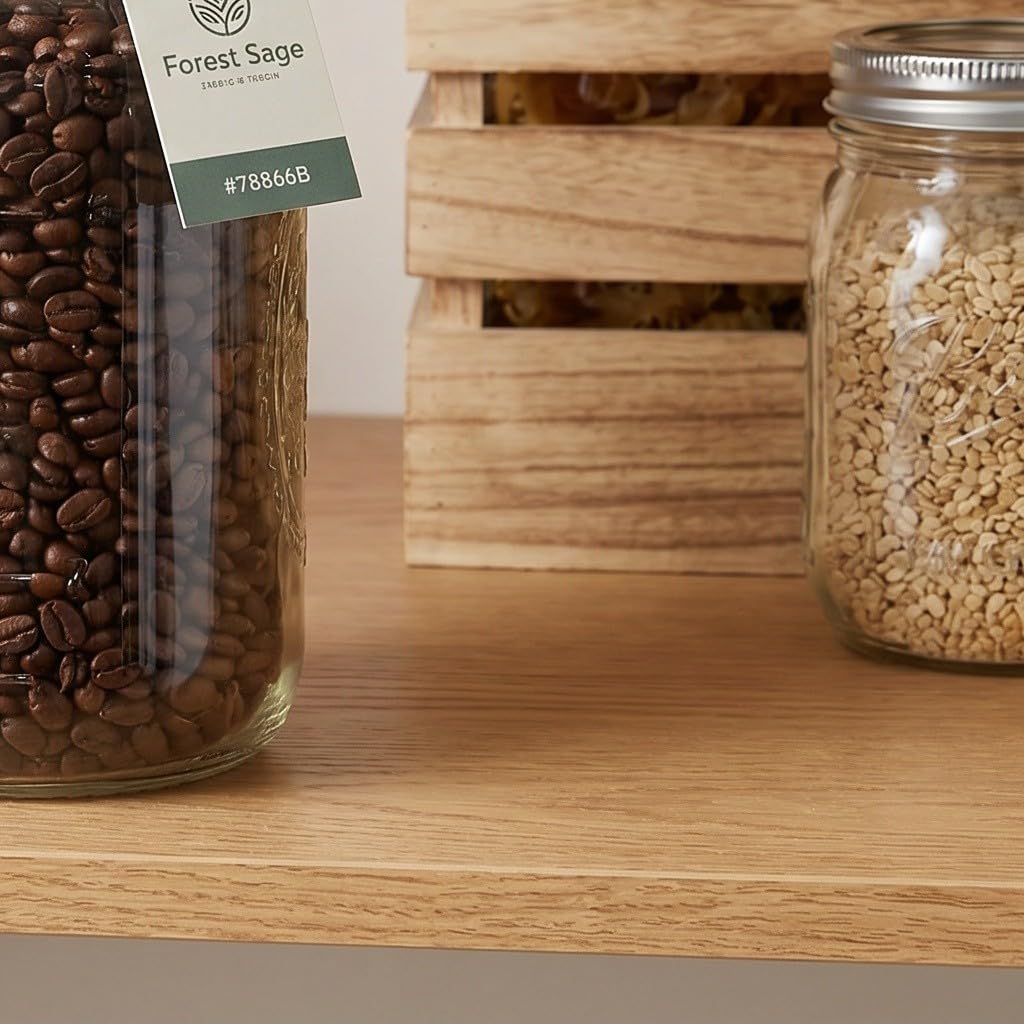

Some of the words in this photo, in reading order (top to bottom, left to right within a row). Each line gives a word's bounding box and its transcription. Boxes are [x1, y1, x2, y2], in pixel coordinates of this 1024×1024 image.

[162, 48, 241, 77] Forest
[245, 42, 304, 67] Sage
[224, 165, 311, 195] #78866B
